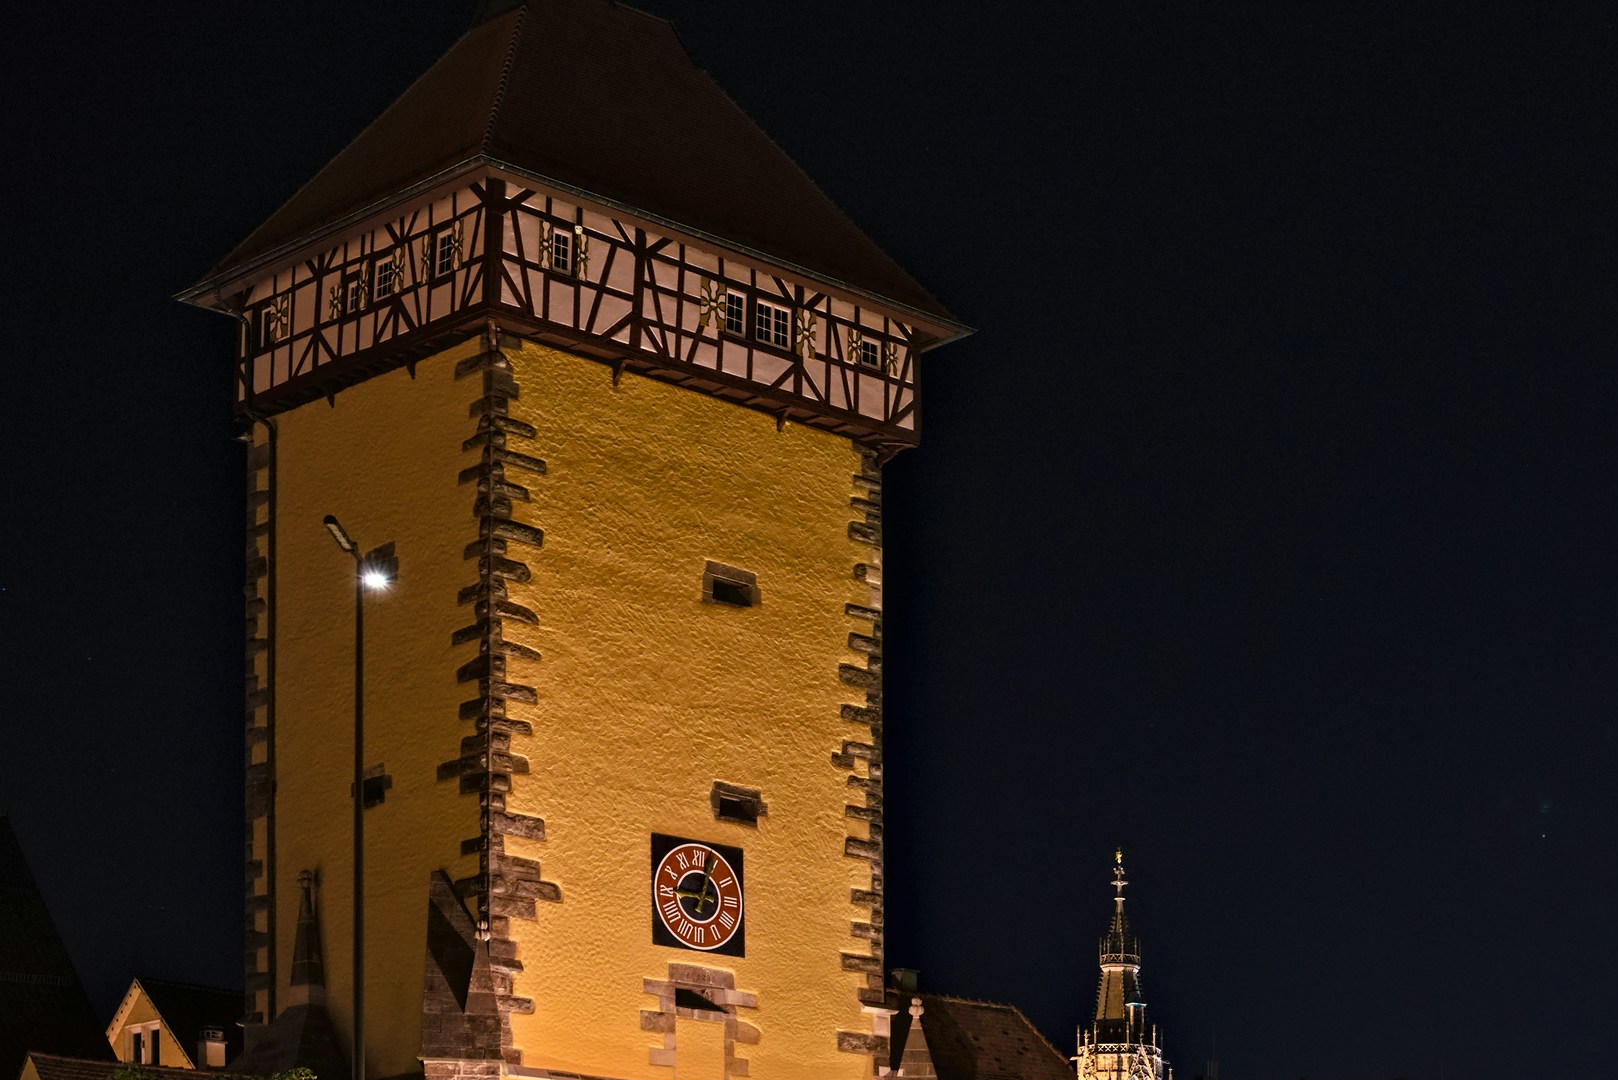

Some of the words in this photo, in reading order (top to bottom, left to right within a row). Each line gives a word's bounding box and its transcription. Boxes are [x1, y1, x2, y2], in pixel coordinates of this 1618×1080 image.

[676, 852, 690, 870] XI
[692, 849, 705, 867] XII
[664, 865, 678, 880] X
[719, 876, 733, 888] II
[660, 884, 674, 897] IX
[724, 896, 737, 908] III
